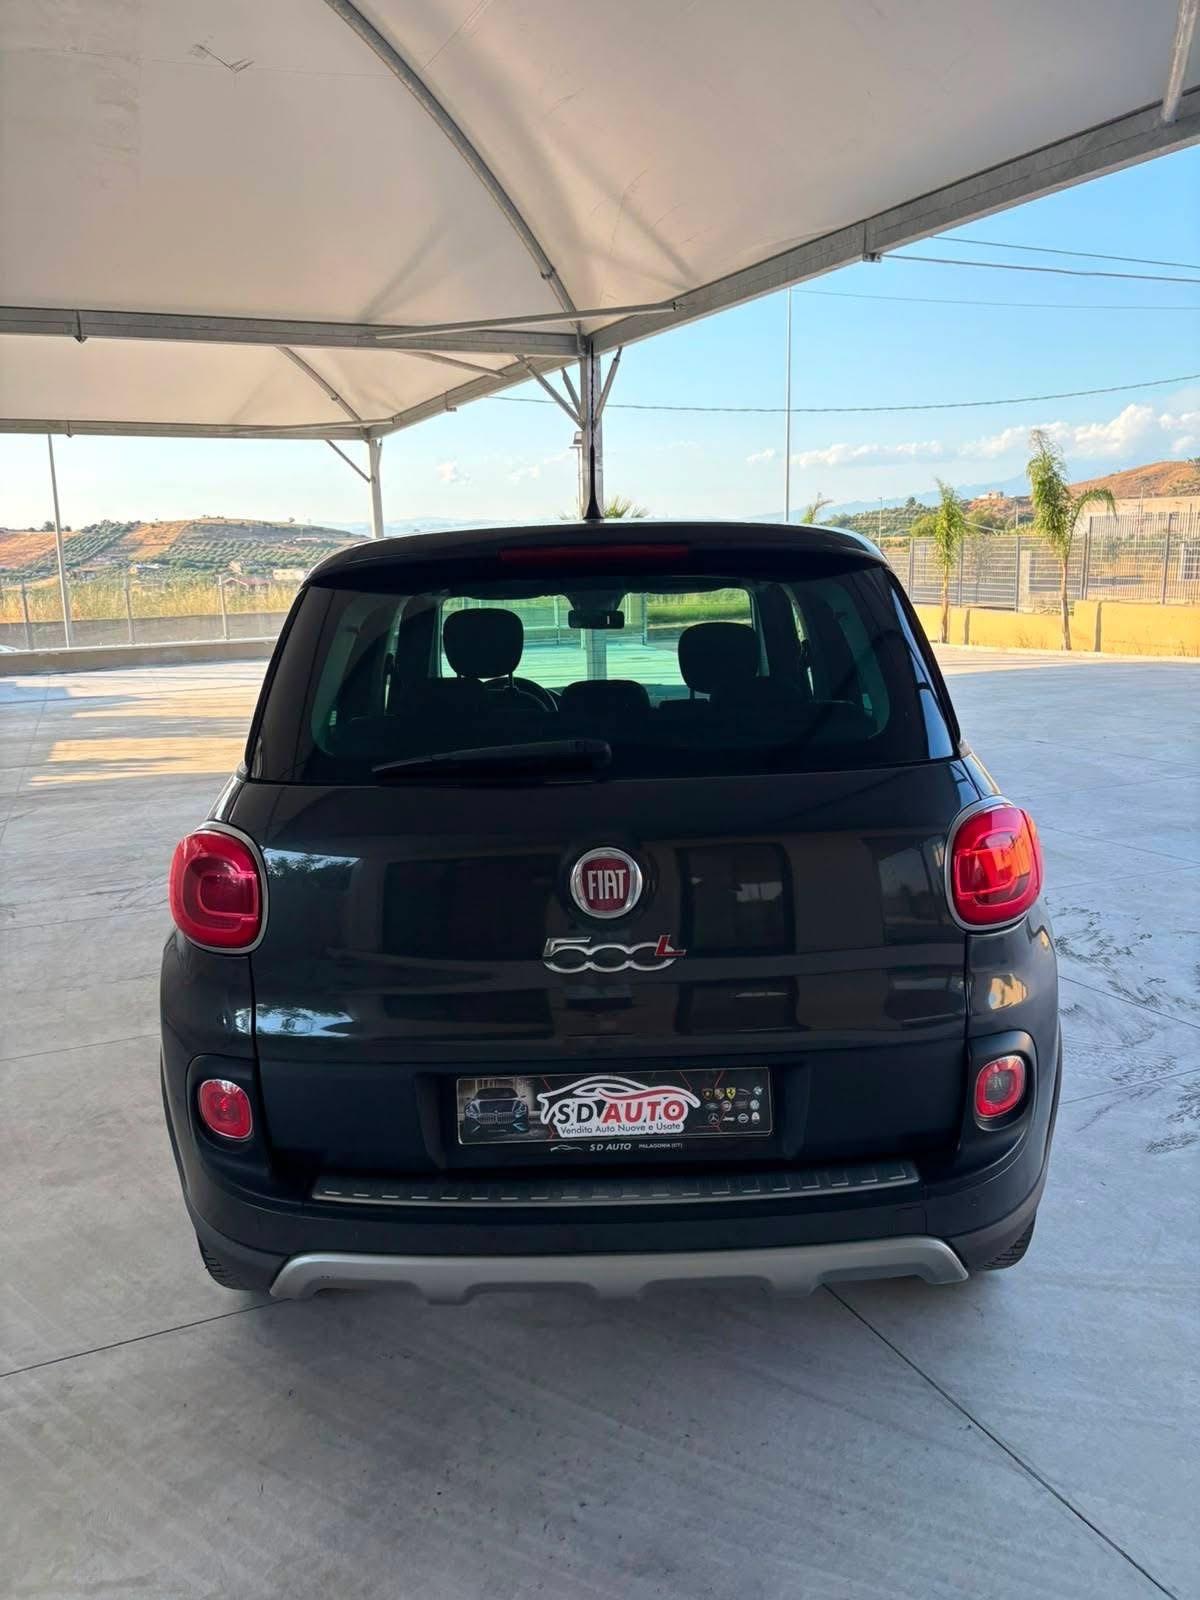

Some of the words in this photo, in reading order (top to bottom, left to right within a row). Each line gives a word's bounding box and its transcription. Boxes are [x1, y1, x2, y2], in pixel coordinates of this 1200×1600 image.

[587, 869, 626, 900] FIAT
[543, 934, 686, 973] 500L
[557, 1102, 594, 1124] SD
[602, 1100, 685, 1123] AUTO
[560, 1126, 593, 1135] Vendita
[595, 1125, 615, 1133] Auto
[618, 1124, 646, 1132] Nuove
[656, 1122, 681, 1131] Usate
[606, 1142, 632, 1151] AUTO
